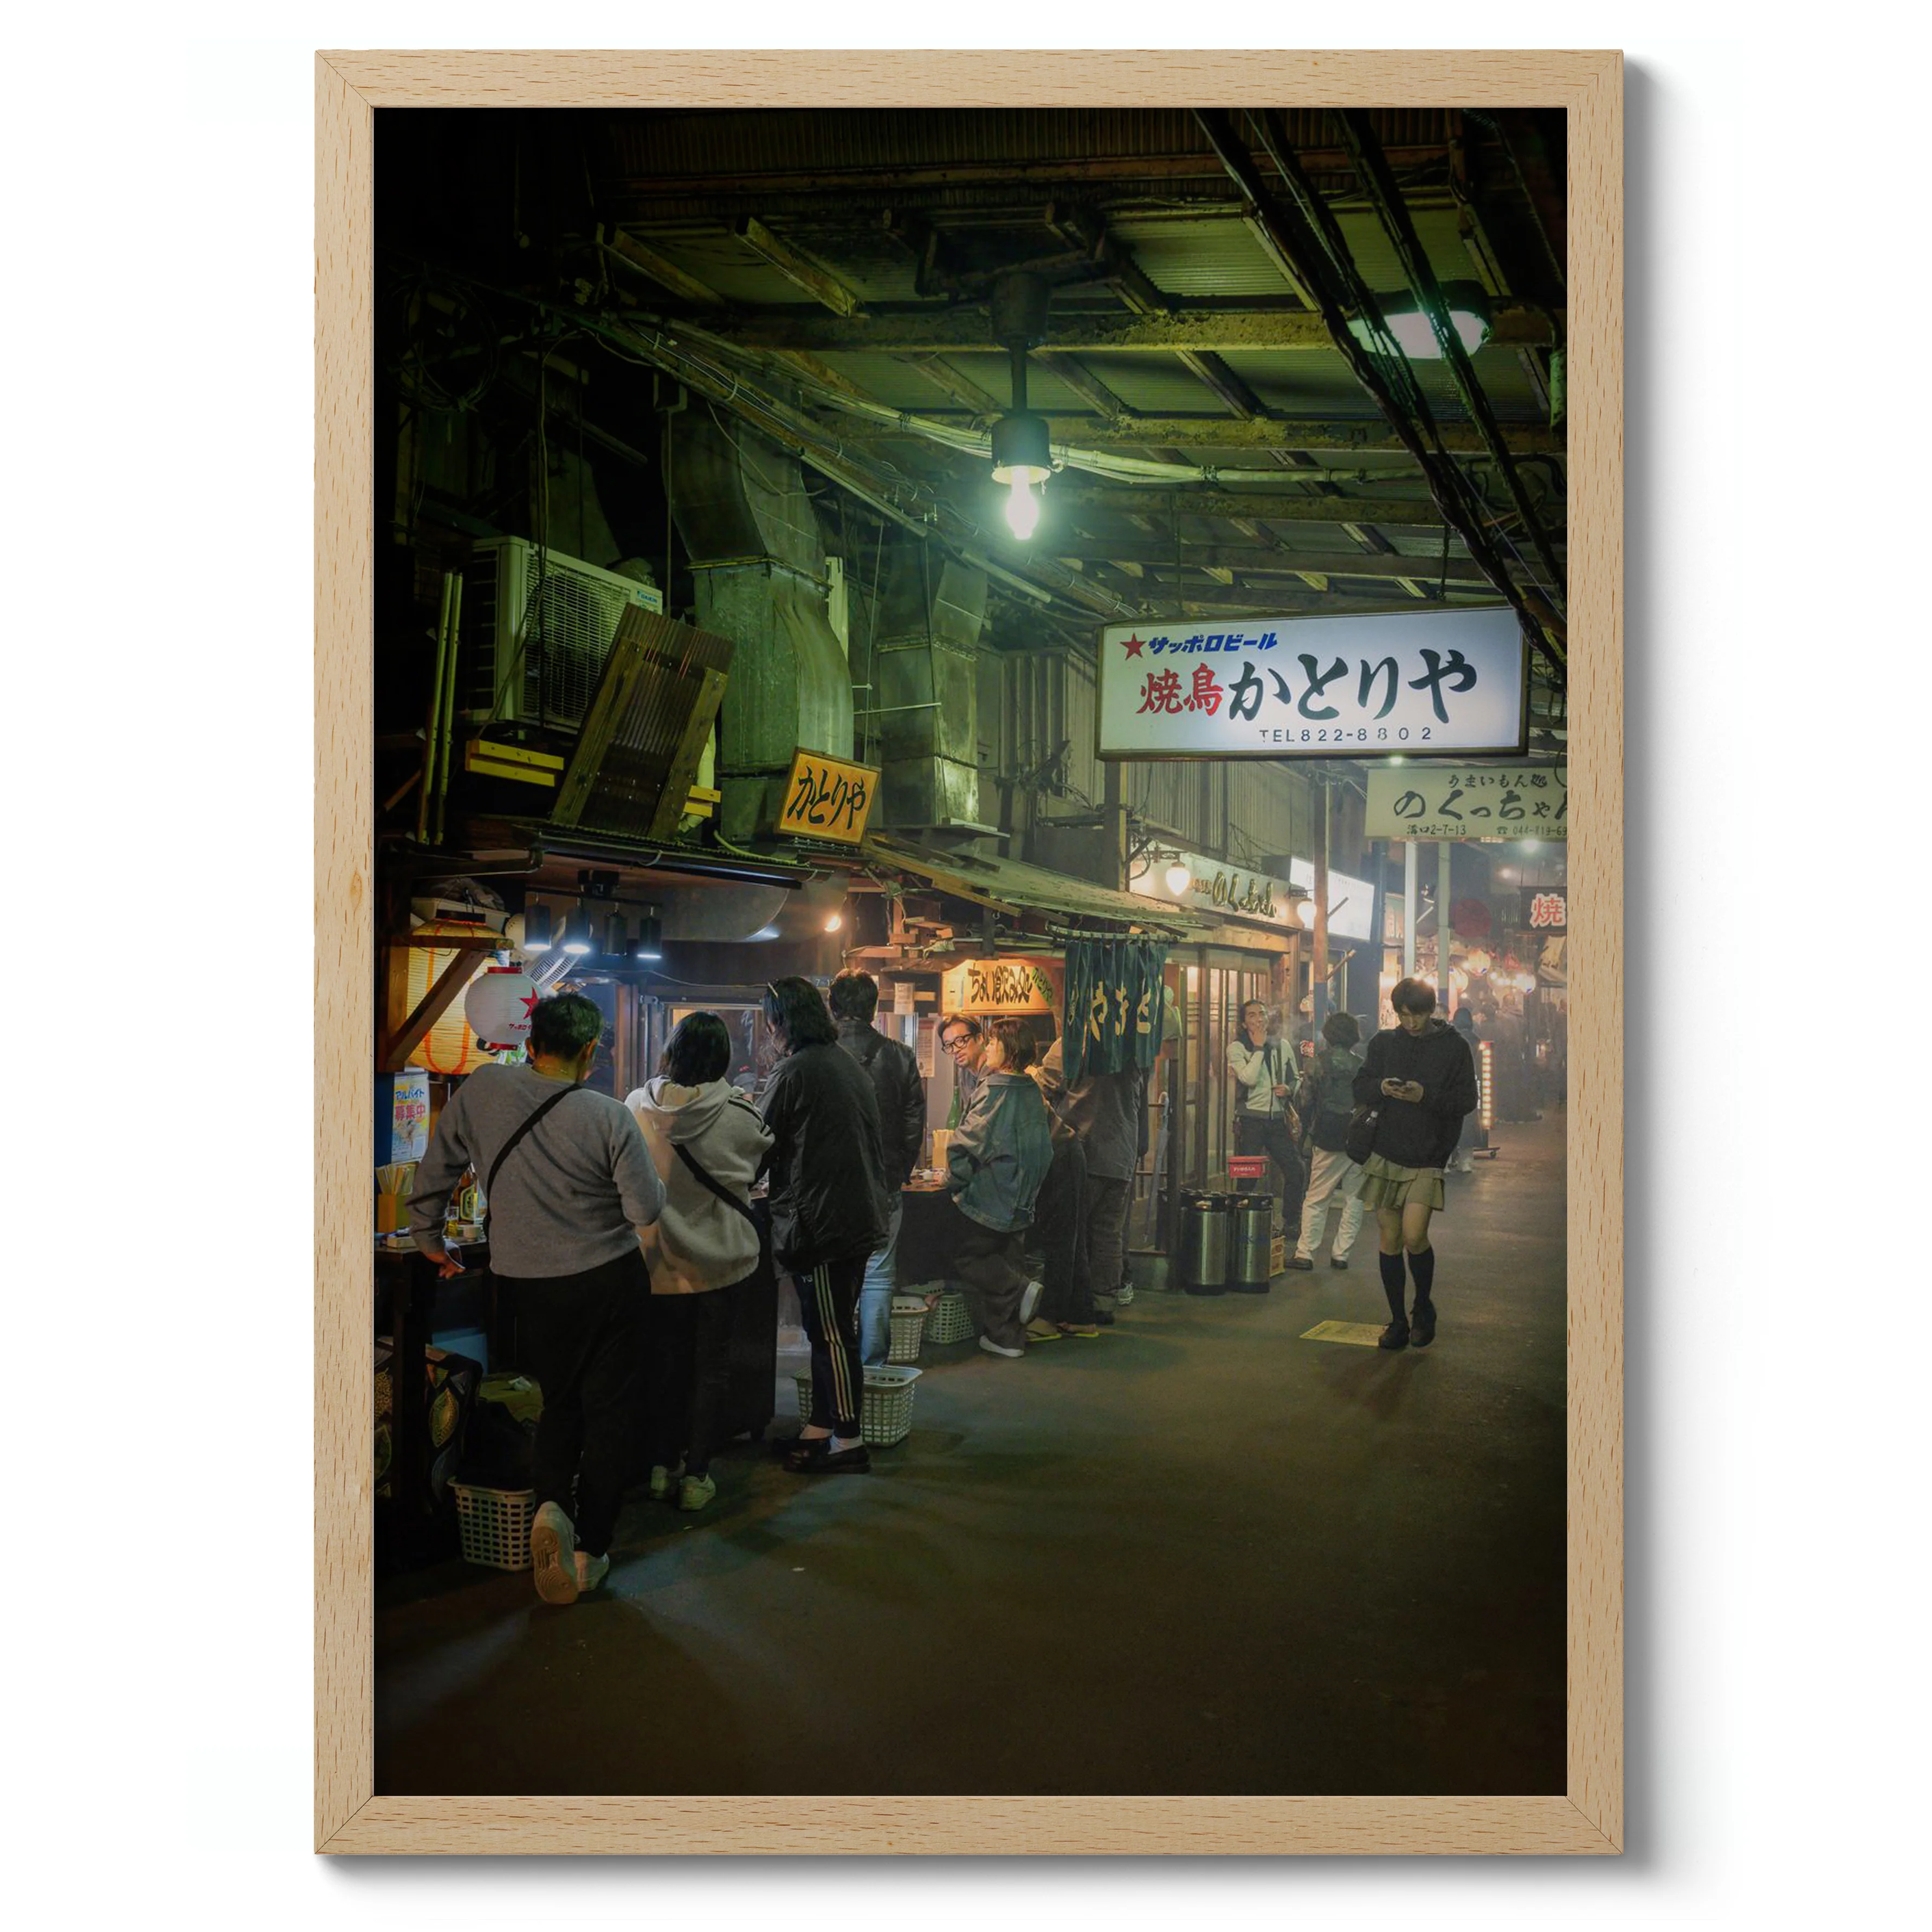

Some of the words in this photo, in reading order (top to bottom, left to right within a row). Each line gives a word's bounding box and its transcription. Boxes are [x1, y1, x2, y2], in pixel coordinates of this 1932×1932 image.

[1148, 632, 1278, 654] サッポロビール
[787, 765, 866, 830] かとりや
[1530, 894, 1566, 927] 焼
[395, 1102, 426, 1121] 募集中
